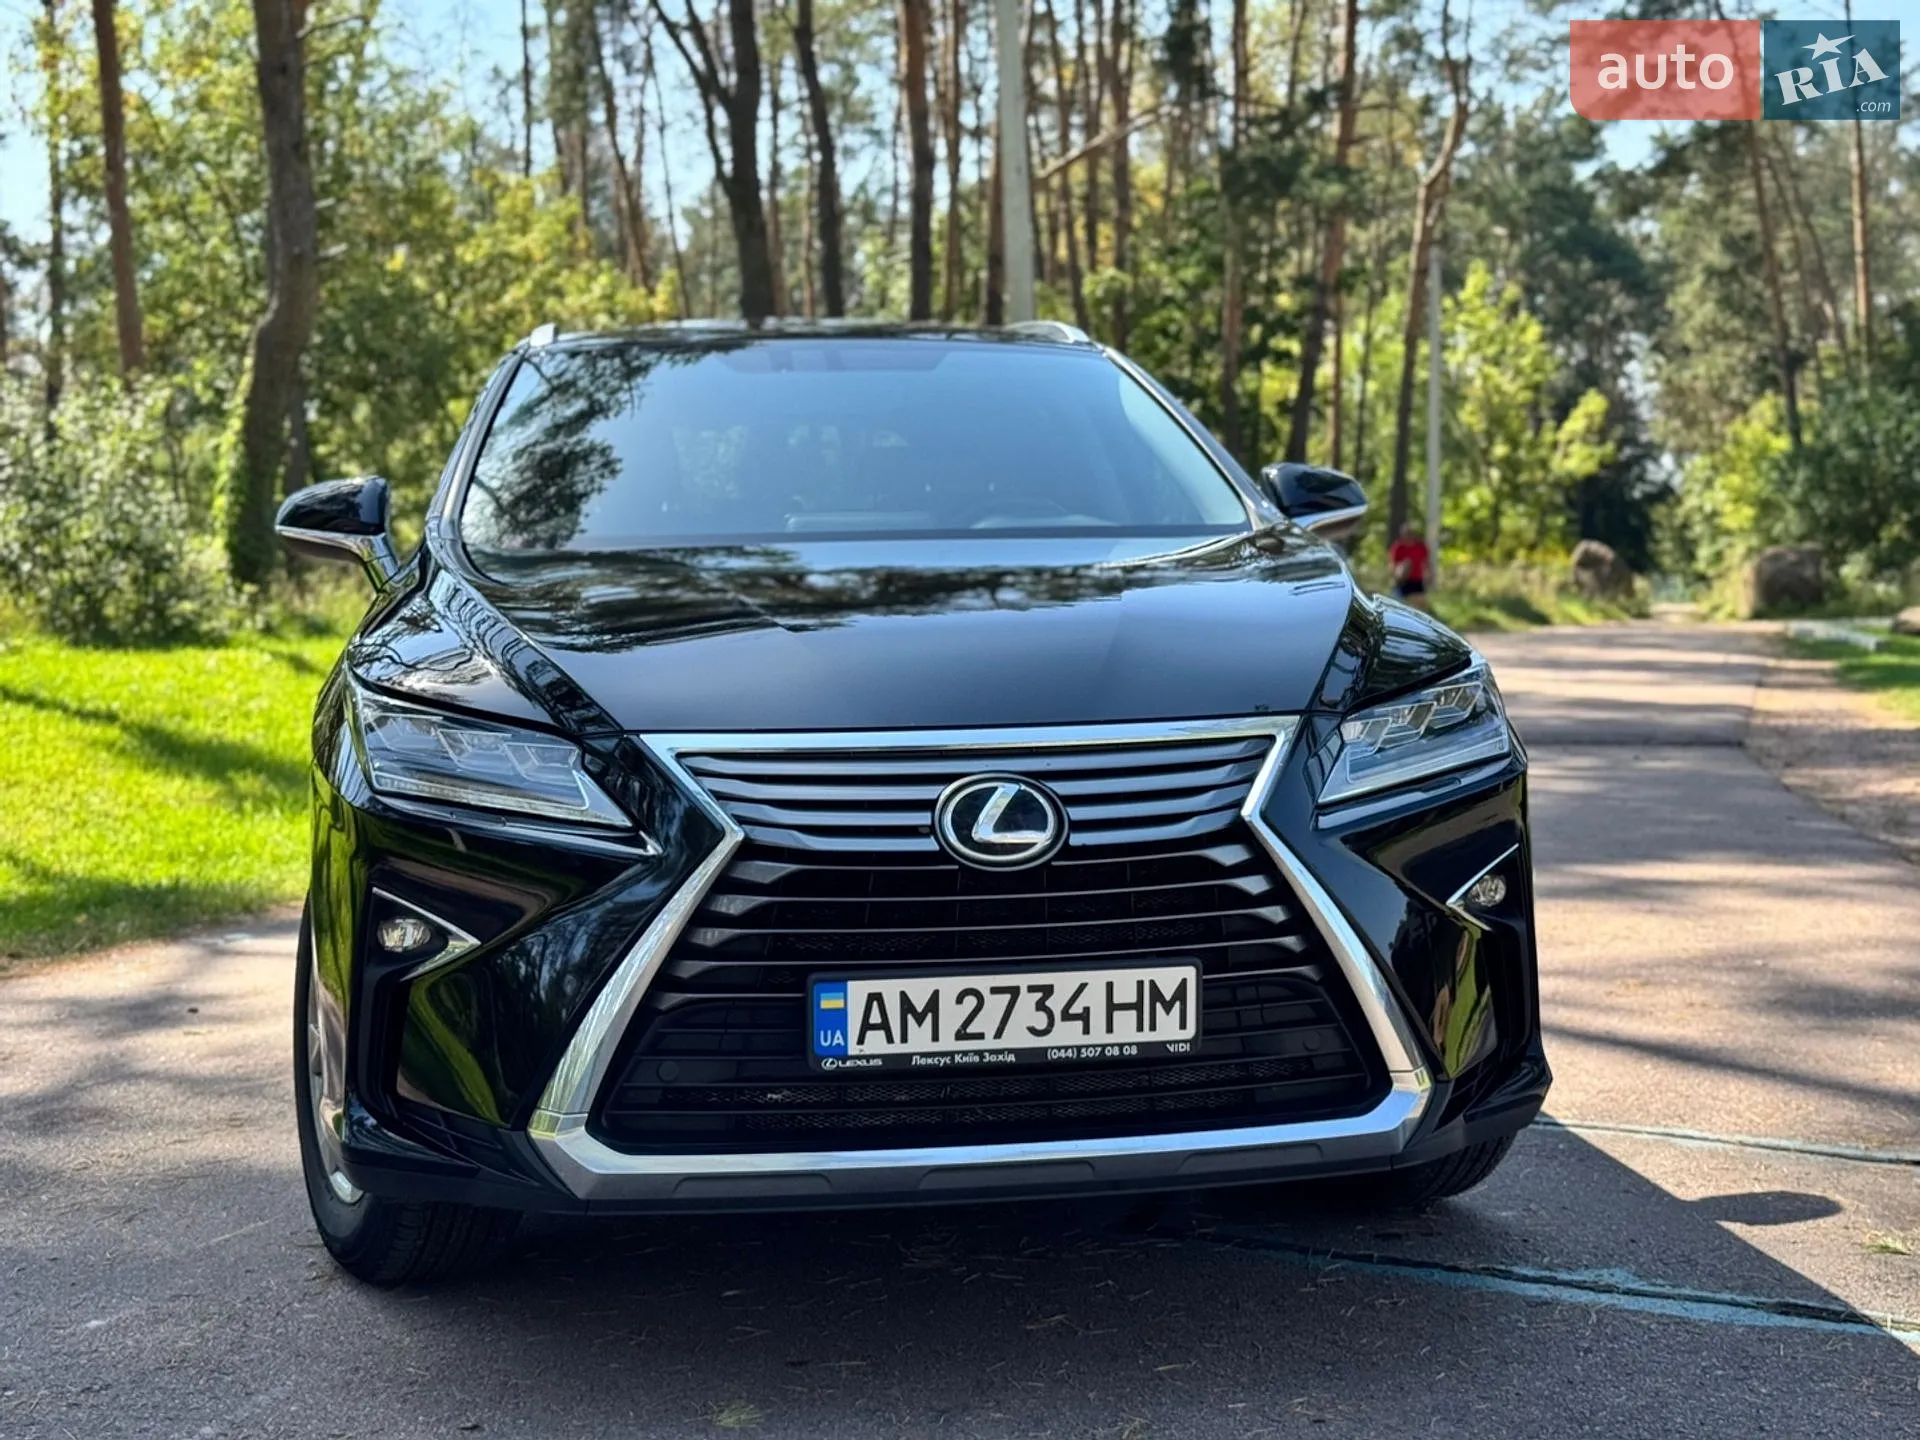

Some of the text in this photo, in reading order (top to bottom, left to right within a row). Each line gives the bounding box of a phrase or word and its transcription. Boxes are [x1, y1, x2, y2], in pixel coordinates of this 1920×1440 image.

[855, 977, 1189, 1046] AM 2734 HM
[820, 1030, 845, 1048] UA
[1047, 1044, 1138, 1060] (044) 507 08 08
[1166, 1042, 1191, 1054] VIDI
[838, 1058, 883, 1068] LEXUS
[911, 1055, 952, 1067] Лексус
[954, 1052, 980, 1064] Київ
